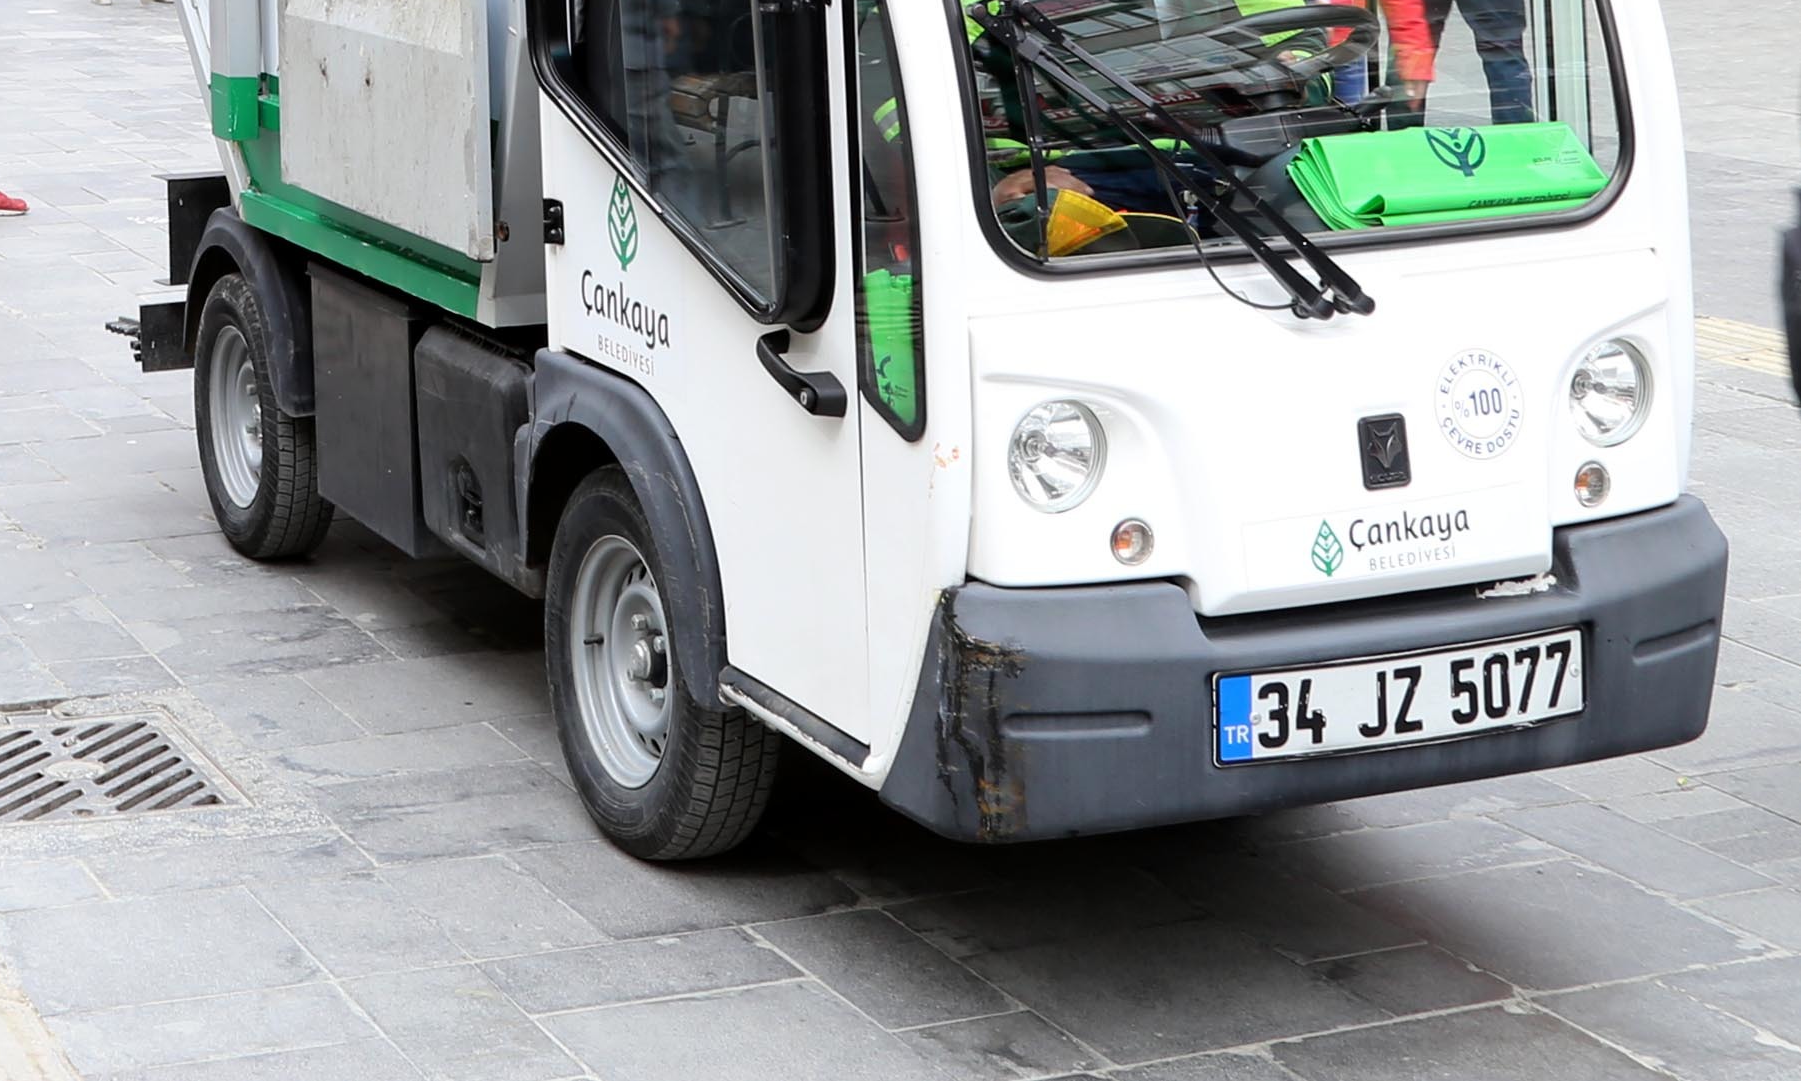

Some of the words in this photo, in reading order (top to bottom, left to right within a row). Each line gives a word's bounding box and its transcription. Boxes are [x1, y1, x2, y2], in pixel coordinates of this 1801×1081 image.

[580, 269, 671, 349] Çankaya
[597, 333, 655, 377] BELEDİYESİ
[1348, 508, 1471, 552] Çankaya
[1369, 545, 1457, 572] BELEDİYESİ
[1257, 677, 1327, 749] 34
[1358, 664, 1424, 740] JZ
[1449, 639, 1573, 726] 5077
[1224, 723, 1250, 746] TR
